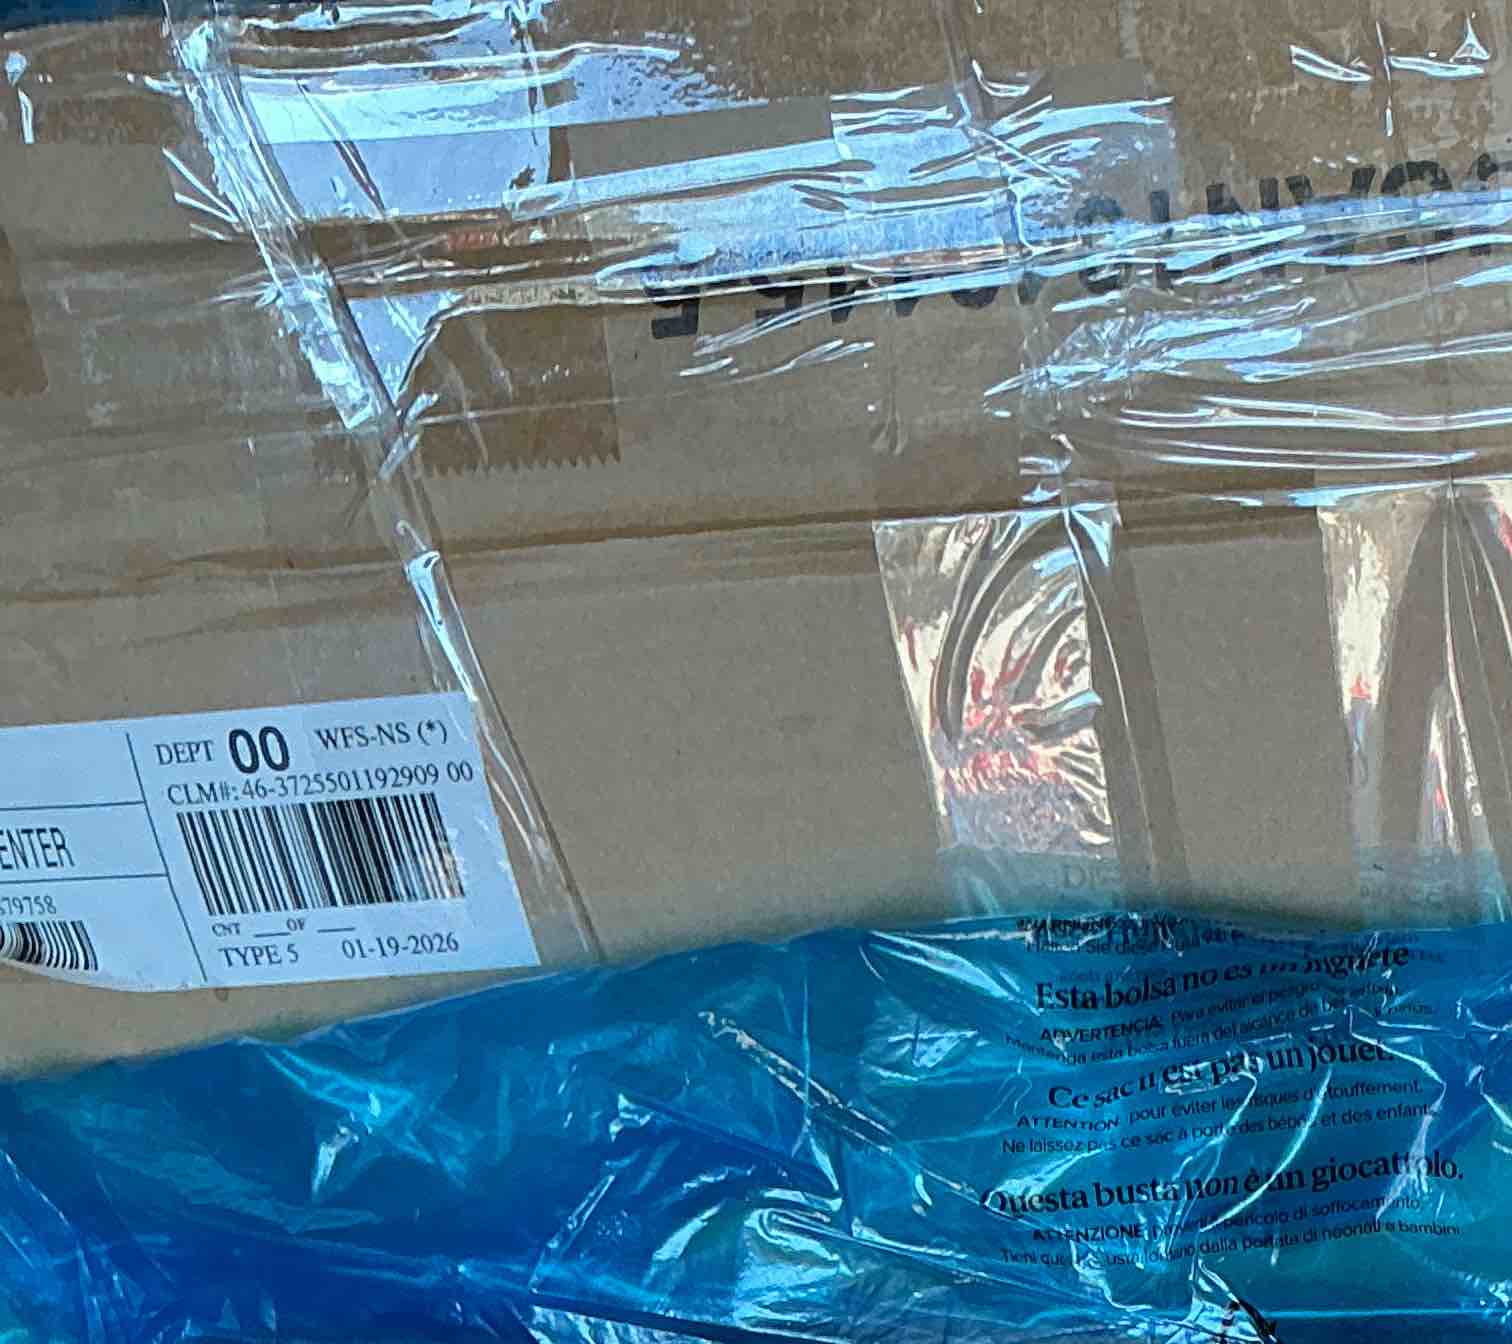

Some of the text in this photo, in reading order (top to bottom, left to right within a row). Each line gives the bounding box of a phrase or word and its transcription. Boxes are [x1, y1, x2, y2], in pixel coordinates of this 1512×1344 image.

[154, 739, 214, 766] DEPT
[229, 726, 290, 774] 00
[314, 722, 412, 751] WFS-NS
[446, 760, 473, 784] 00
[217, 931, 461, 969] TYPE 5 01-19-2026
[1035, 981, 1098, 1010] Esta
[1104, 976, 1176, 1010] bolsa
[1183, 968, 1218, 992] no
[1049, 1086, 1089, 1109] Ce
[1268, 1047, 1305, 1071] un
[1002, 1139, 1026, 1153] Ne
[1121, 1136, 1143, 1150] ce
[1146, 1131, 1172, 1146] sac
[1342, 1109, 1373, 1127] des
[1129, 1107, 1167, 1126] pour
[1094, 1180, 1178, 1209] busta
[1185, 1173, 1238, 1201] non
[1263, 1171, 1306, 1192] un
